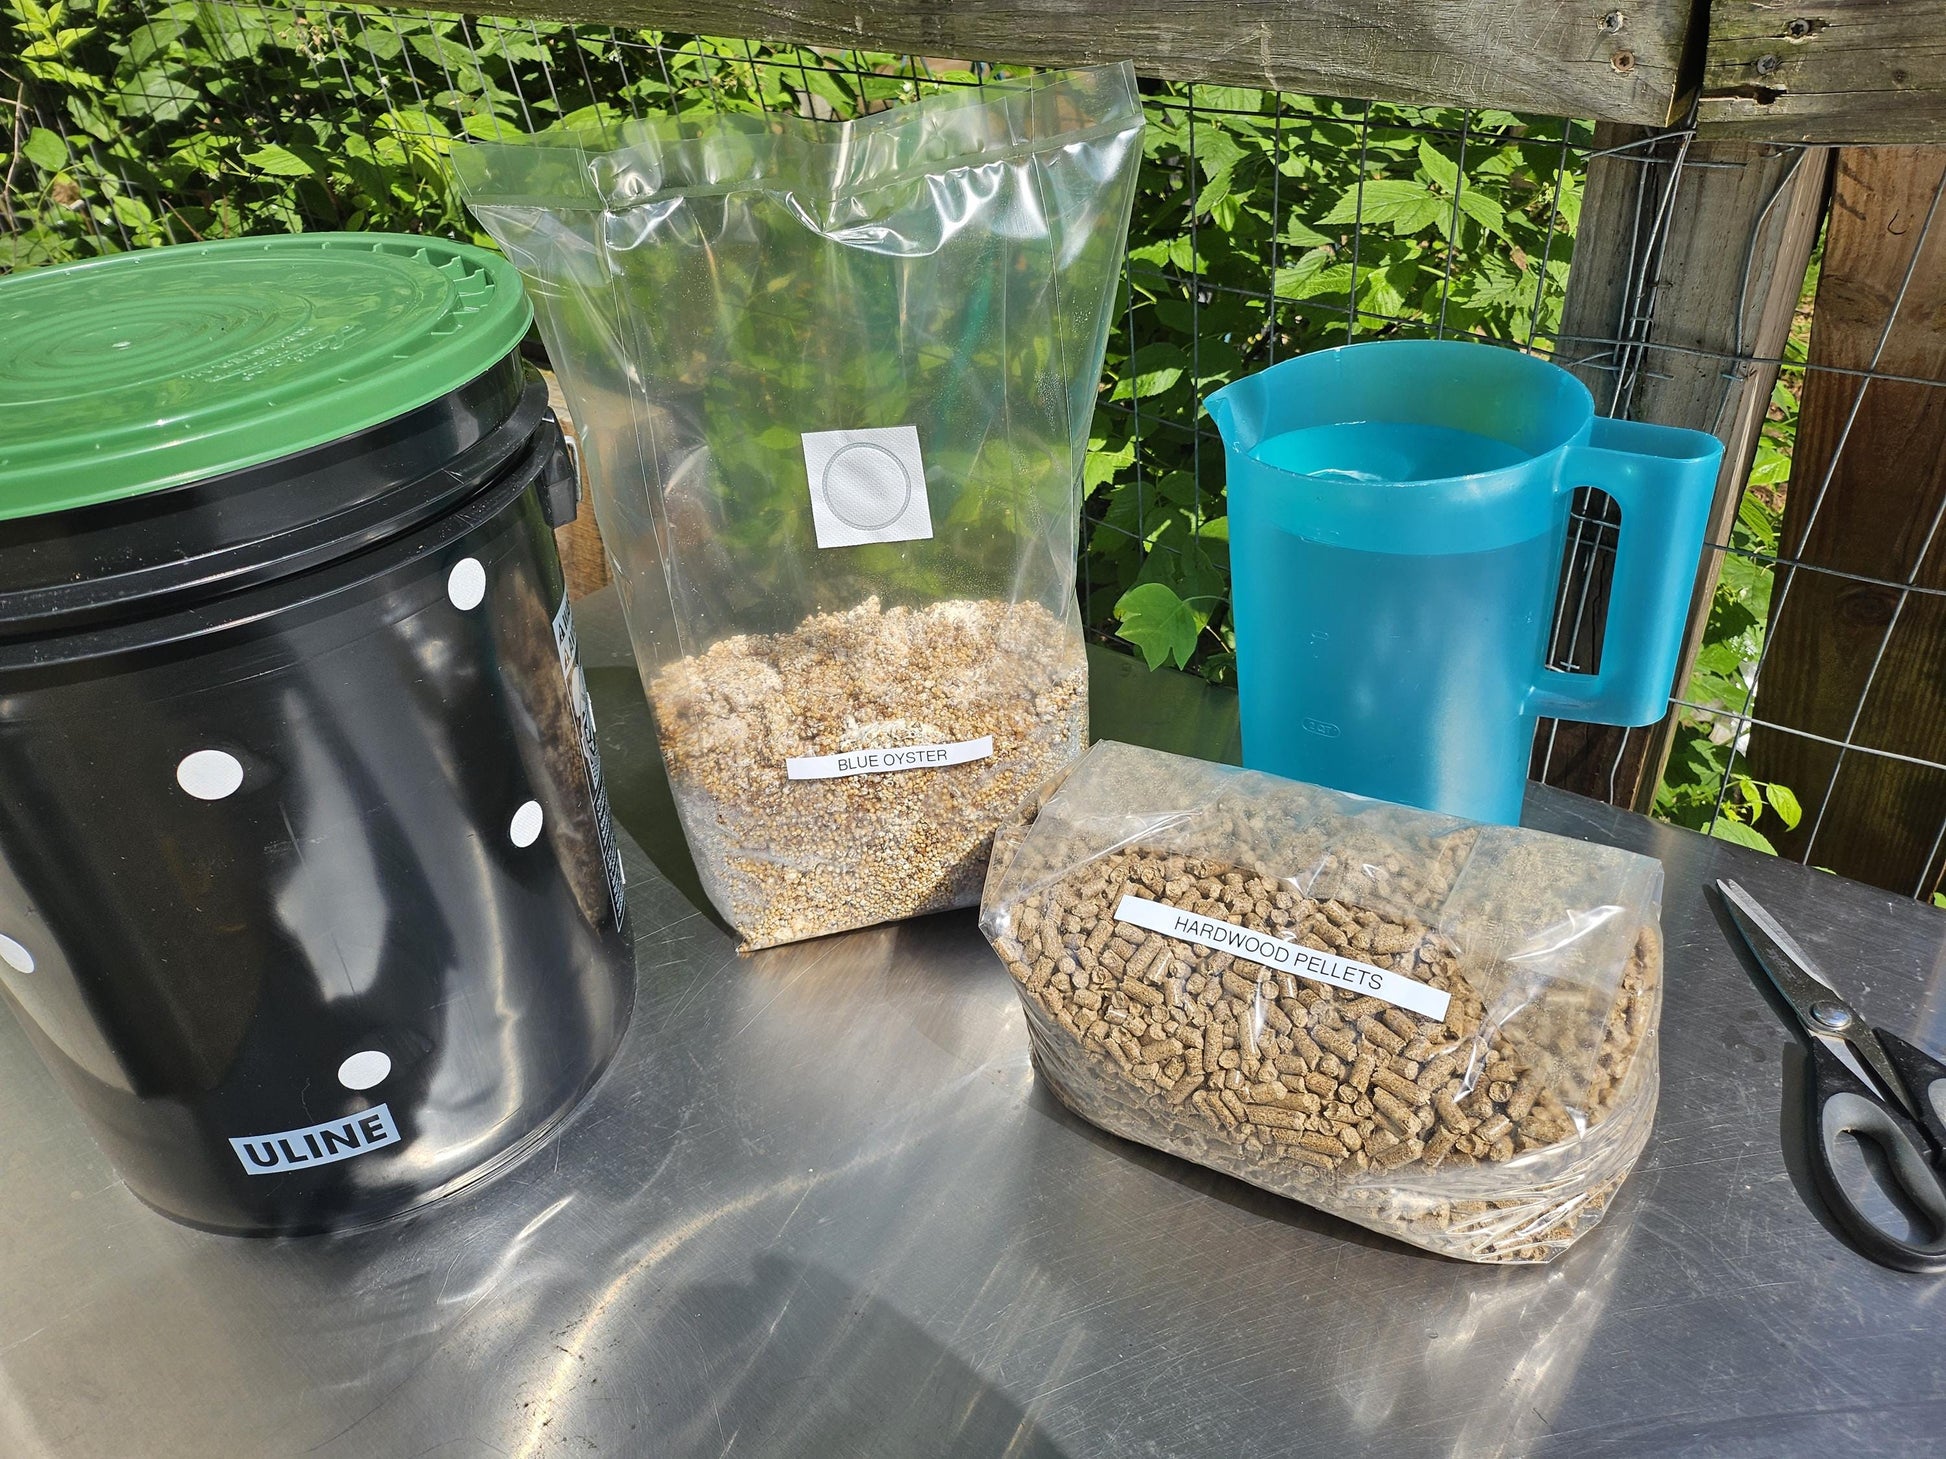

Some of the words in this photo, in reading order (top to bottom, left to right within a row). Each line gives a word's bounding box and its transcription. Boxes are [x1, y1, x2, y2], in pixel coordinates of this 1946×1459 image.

[838, 754, 879, 772] BLUE
[883, 749, 948, 767] OYSTER
[1174, 916, 1290, 963] HARDWOOD
[1295, 953, 1384, 991] PELLETS
[243, 1114, 388, 1168] ULINE
